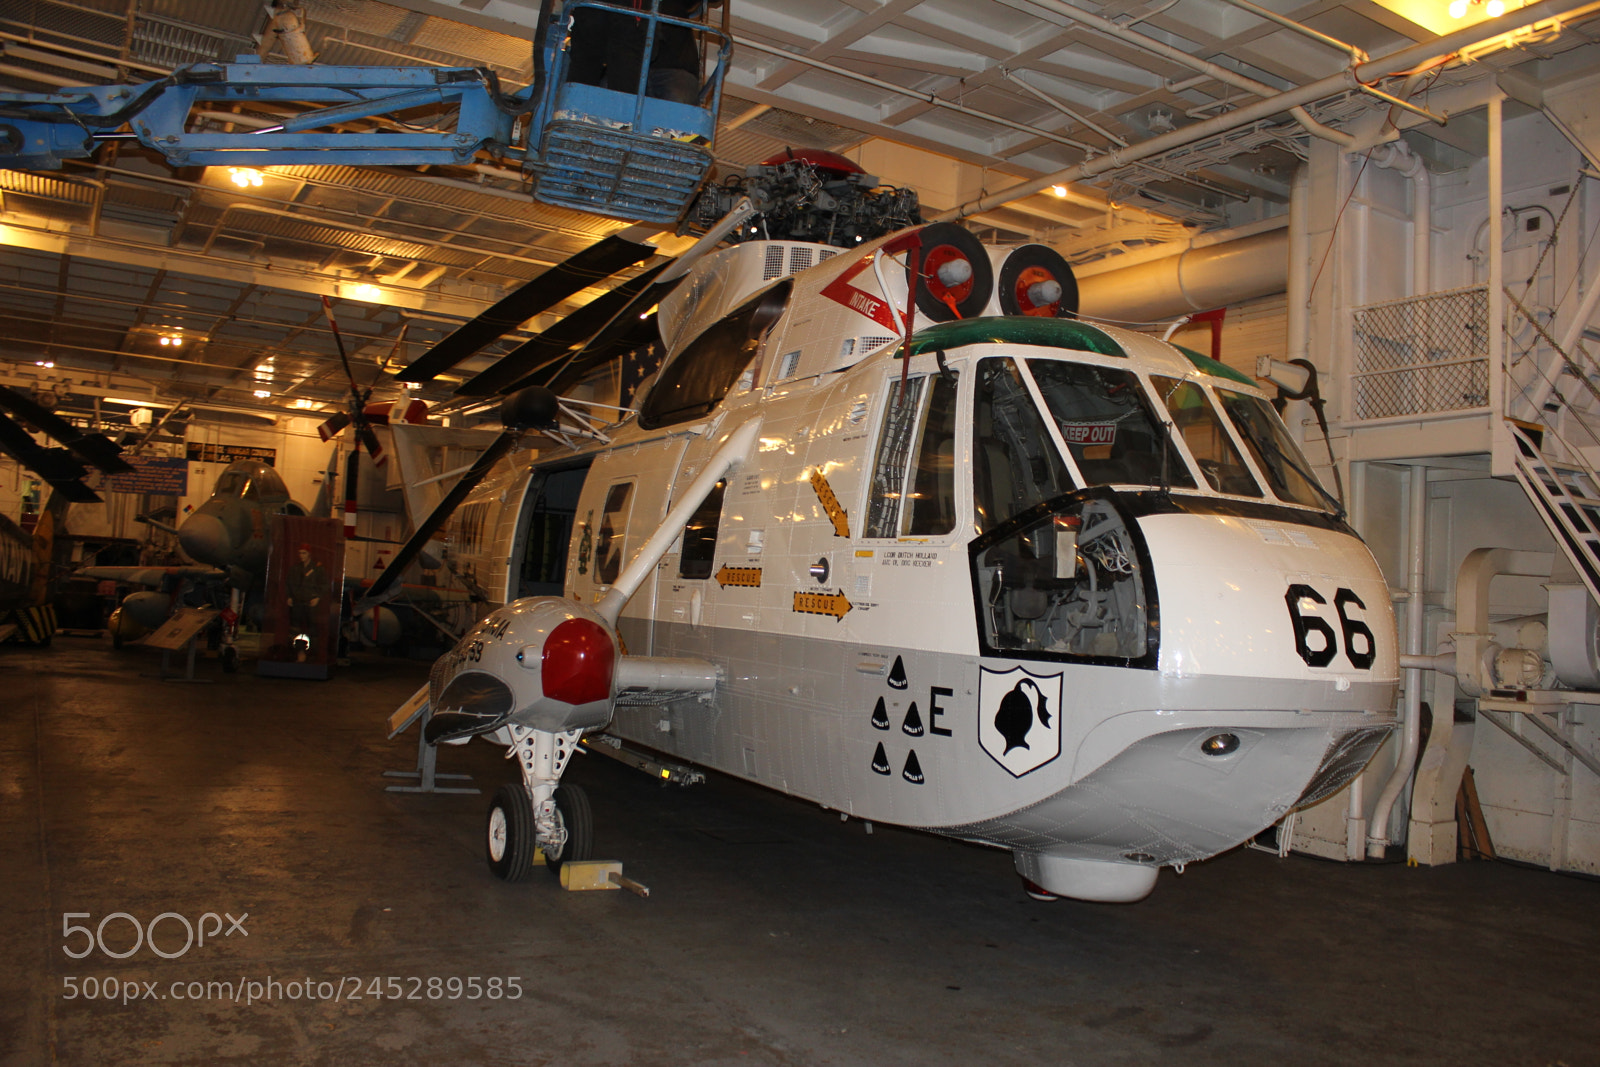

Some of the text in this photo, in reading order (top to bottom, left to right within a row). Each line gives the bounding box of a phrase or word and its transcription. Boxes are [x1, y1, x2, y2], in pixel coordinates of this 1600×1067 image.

[849, 292, 881, 318] INTAKE
[1063, 426, 1114, 442] KEEP OUT
[816, 477, 840, 521] RESCUE
[915, 552, 938, 560] HOLLAND
[727, 573, 757, 583] RESCUE
[799, 597, 835, 611] RESCUE
[1284, 584, 1377, 670] 66
[929, 686, 954, 737] E
